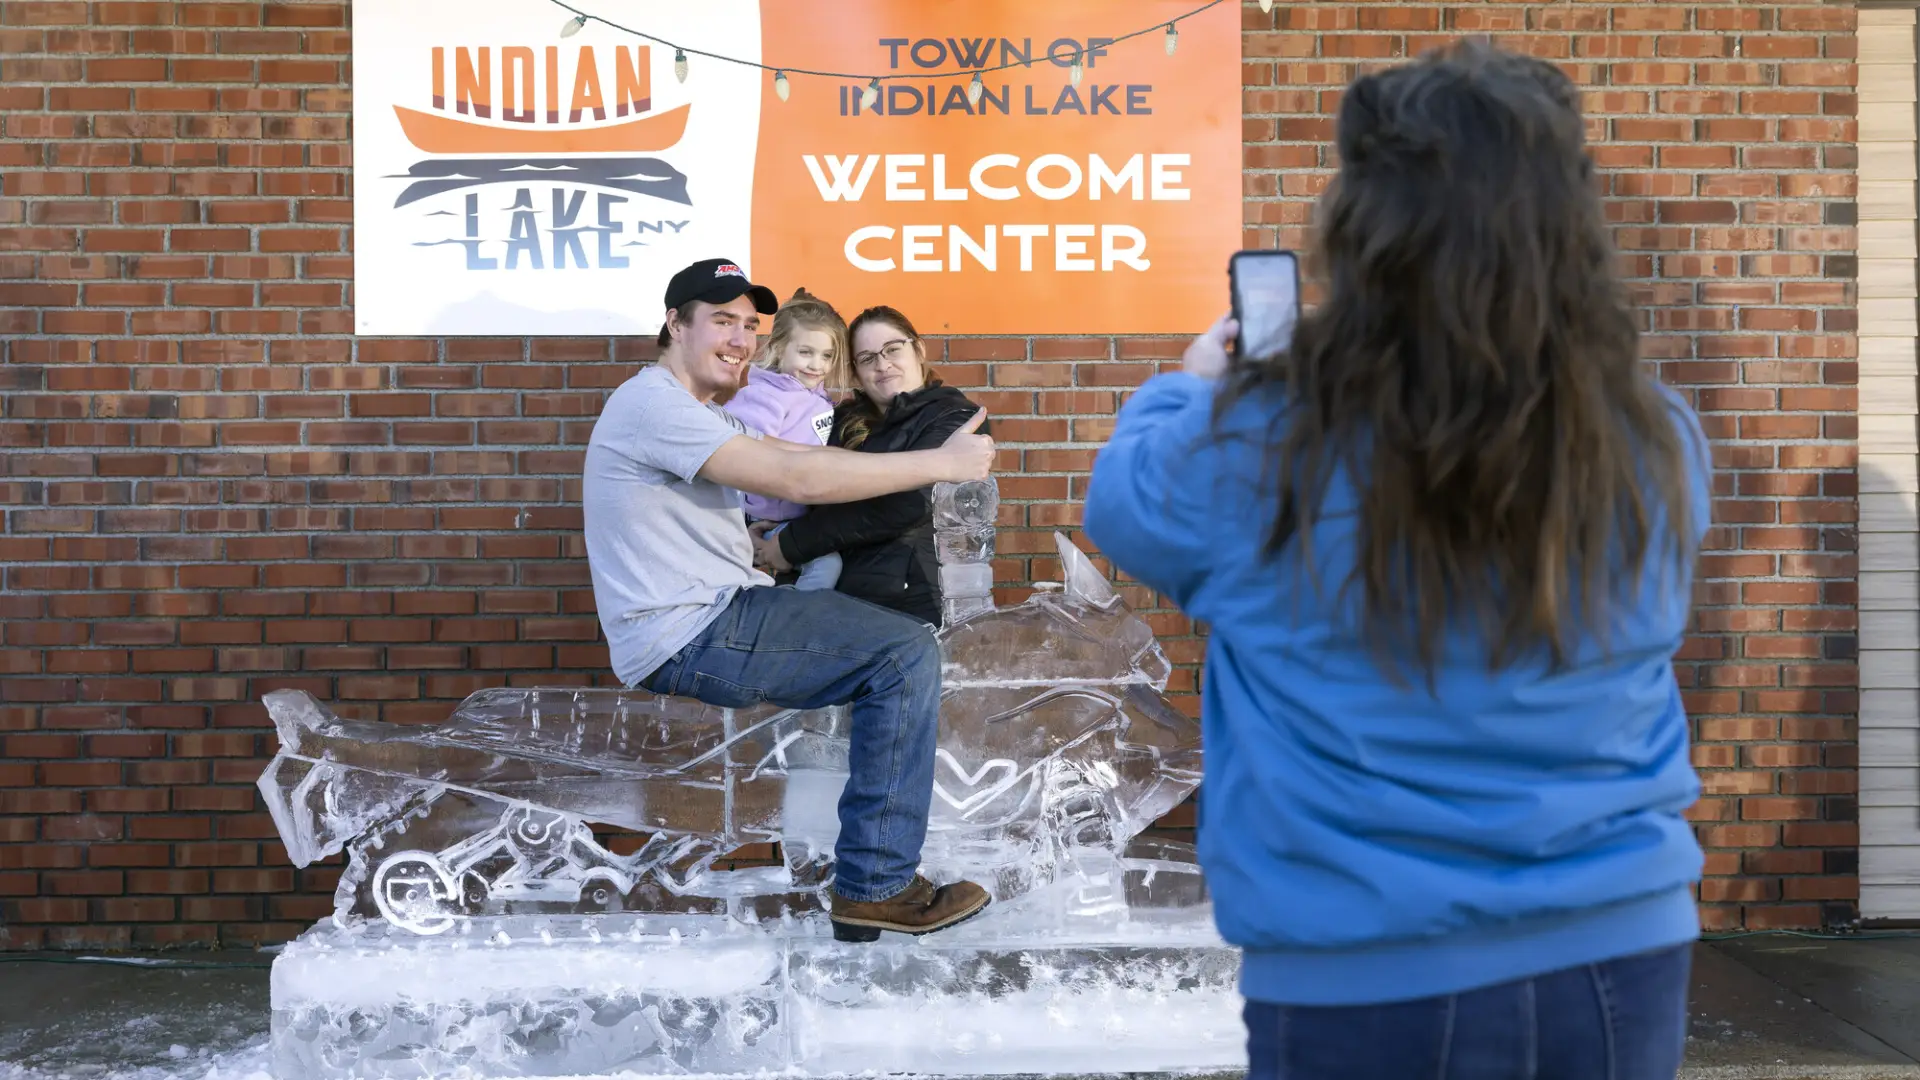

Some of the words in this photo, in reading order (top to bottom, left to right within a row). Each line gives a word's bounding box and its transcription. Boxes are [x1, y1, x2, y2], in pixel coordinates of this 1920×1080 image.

[879, 38, 1032, 68] TOWN
[1047, 38, 1113, 68] OF
[432, 45, 652, 123] INDIAN
[840, 85, 1009, 116] INDIAN
[1025, 85, 1152, 115] LAKE
[802, 153, 1191, 201] WELCOME
[465, 188, 630, 270] LAKE
[638, 220, 690, 234] NY
[844, 224, 1150, 272] CENTER
